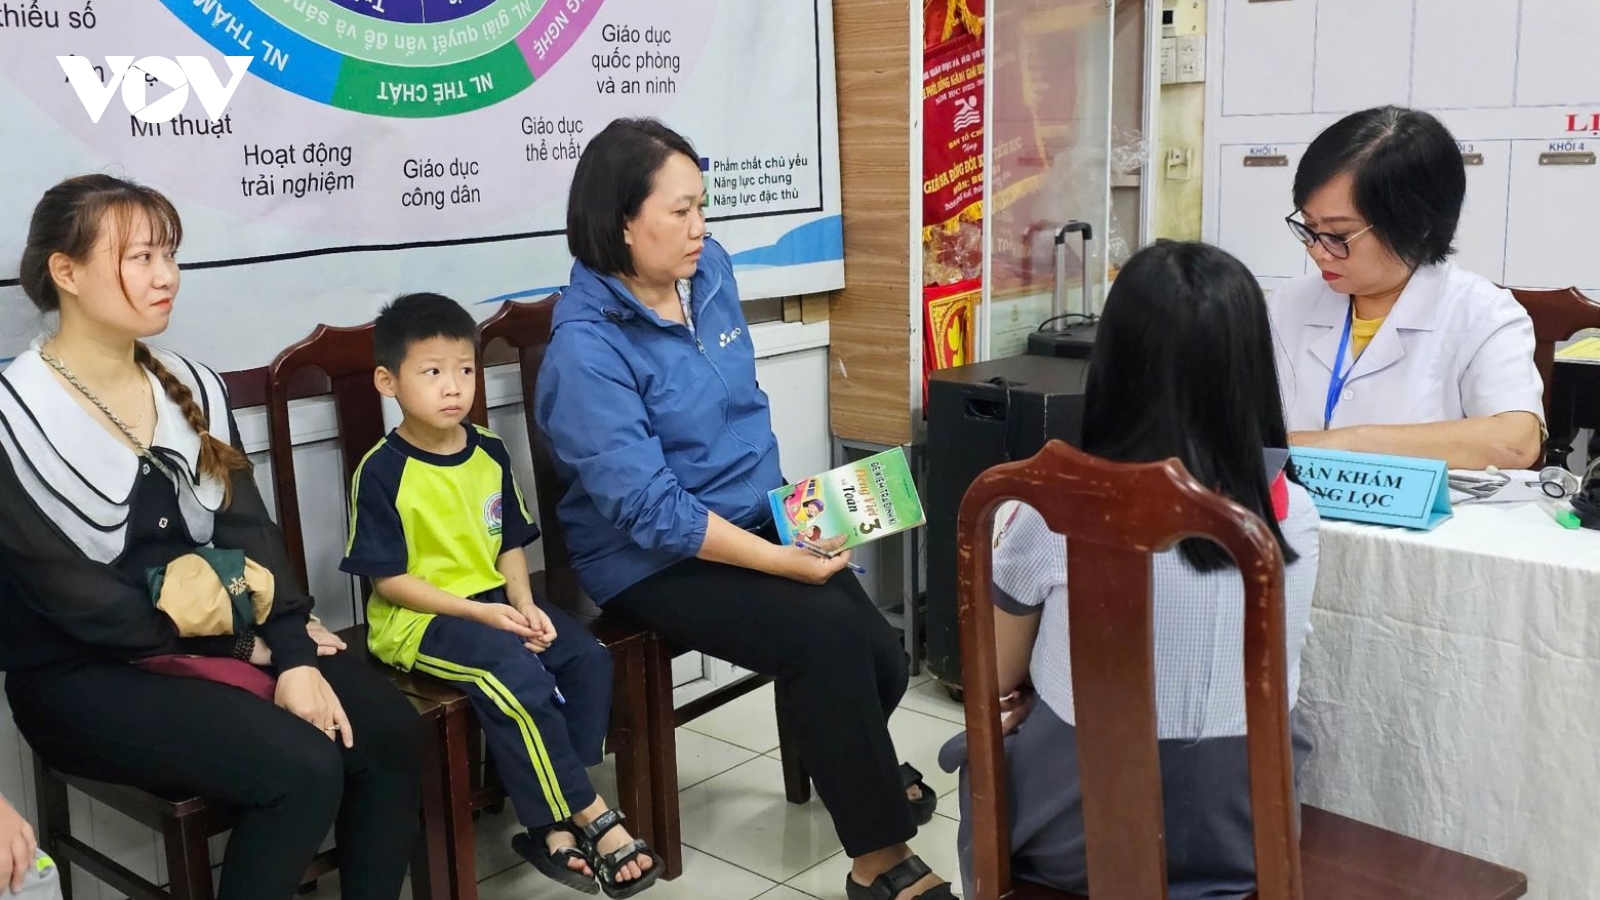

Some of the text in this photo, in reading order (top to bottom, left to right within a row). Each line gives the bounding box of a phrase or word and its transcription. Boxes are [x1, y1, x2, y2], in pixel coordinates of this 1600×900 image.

[68, 0, 96, 29] số
[364, 29, 388, 51] đề
[394, 34, 427, 57] vấn
[431, 28, 479, 56] quyết
[533, 10, 570, 61] NGHỆ
[602, 24, 672, 47] Giáo dục
[261, 39, 290, 72] NL
[591, 47, 680, 73] quốc phòng
[469, 72, 495, 94] NL
[597, 76, 676, 94] và an ninh
[521, 116, 584, 137] Giáo dục
[243, 142, 352, 169] Hoạt động
[525, 137, 581, 161] thể chất
[1468, 144, 1474, 153] 3
[1578, 143, 1585, 151] 4
[403, 157, 480, 180] Giáo dục
[740, 155, 763, 171] chất
[764, 155, 786, 169] chủ
[241, 171, 355, 199] trải nghiệm
[713, 173, 793, 190] Năng lực chung
[401, 184, 481, 210] công dân
[713, 188, 800, 207] Năng lực đặc thù
[1336, 470, 1403, 489] KHÁM
[842, 485, 860, 513] Toán
[1348, 490, 1394, 508] LỌC
[859, 518, 882, 534] 3
